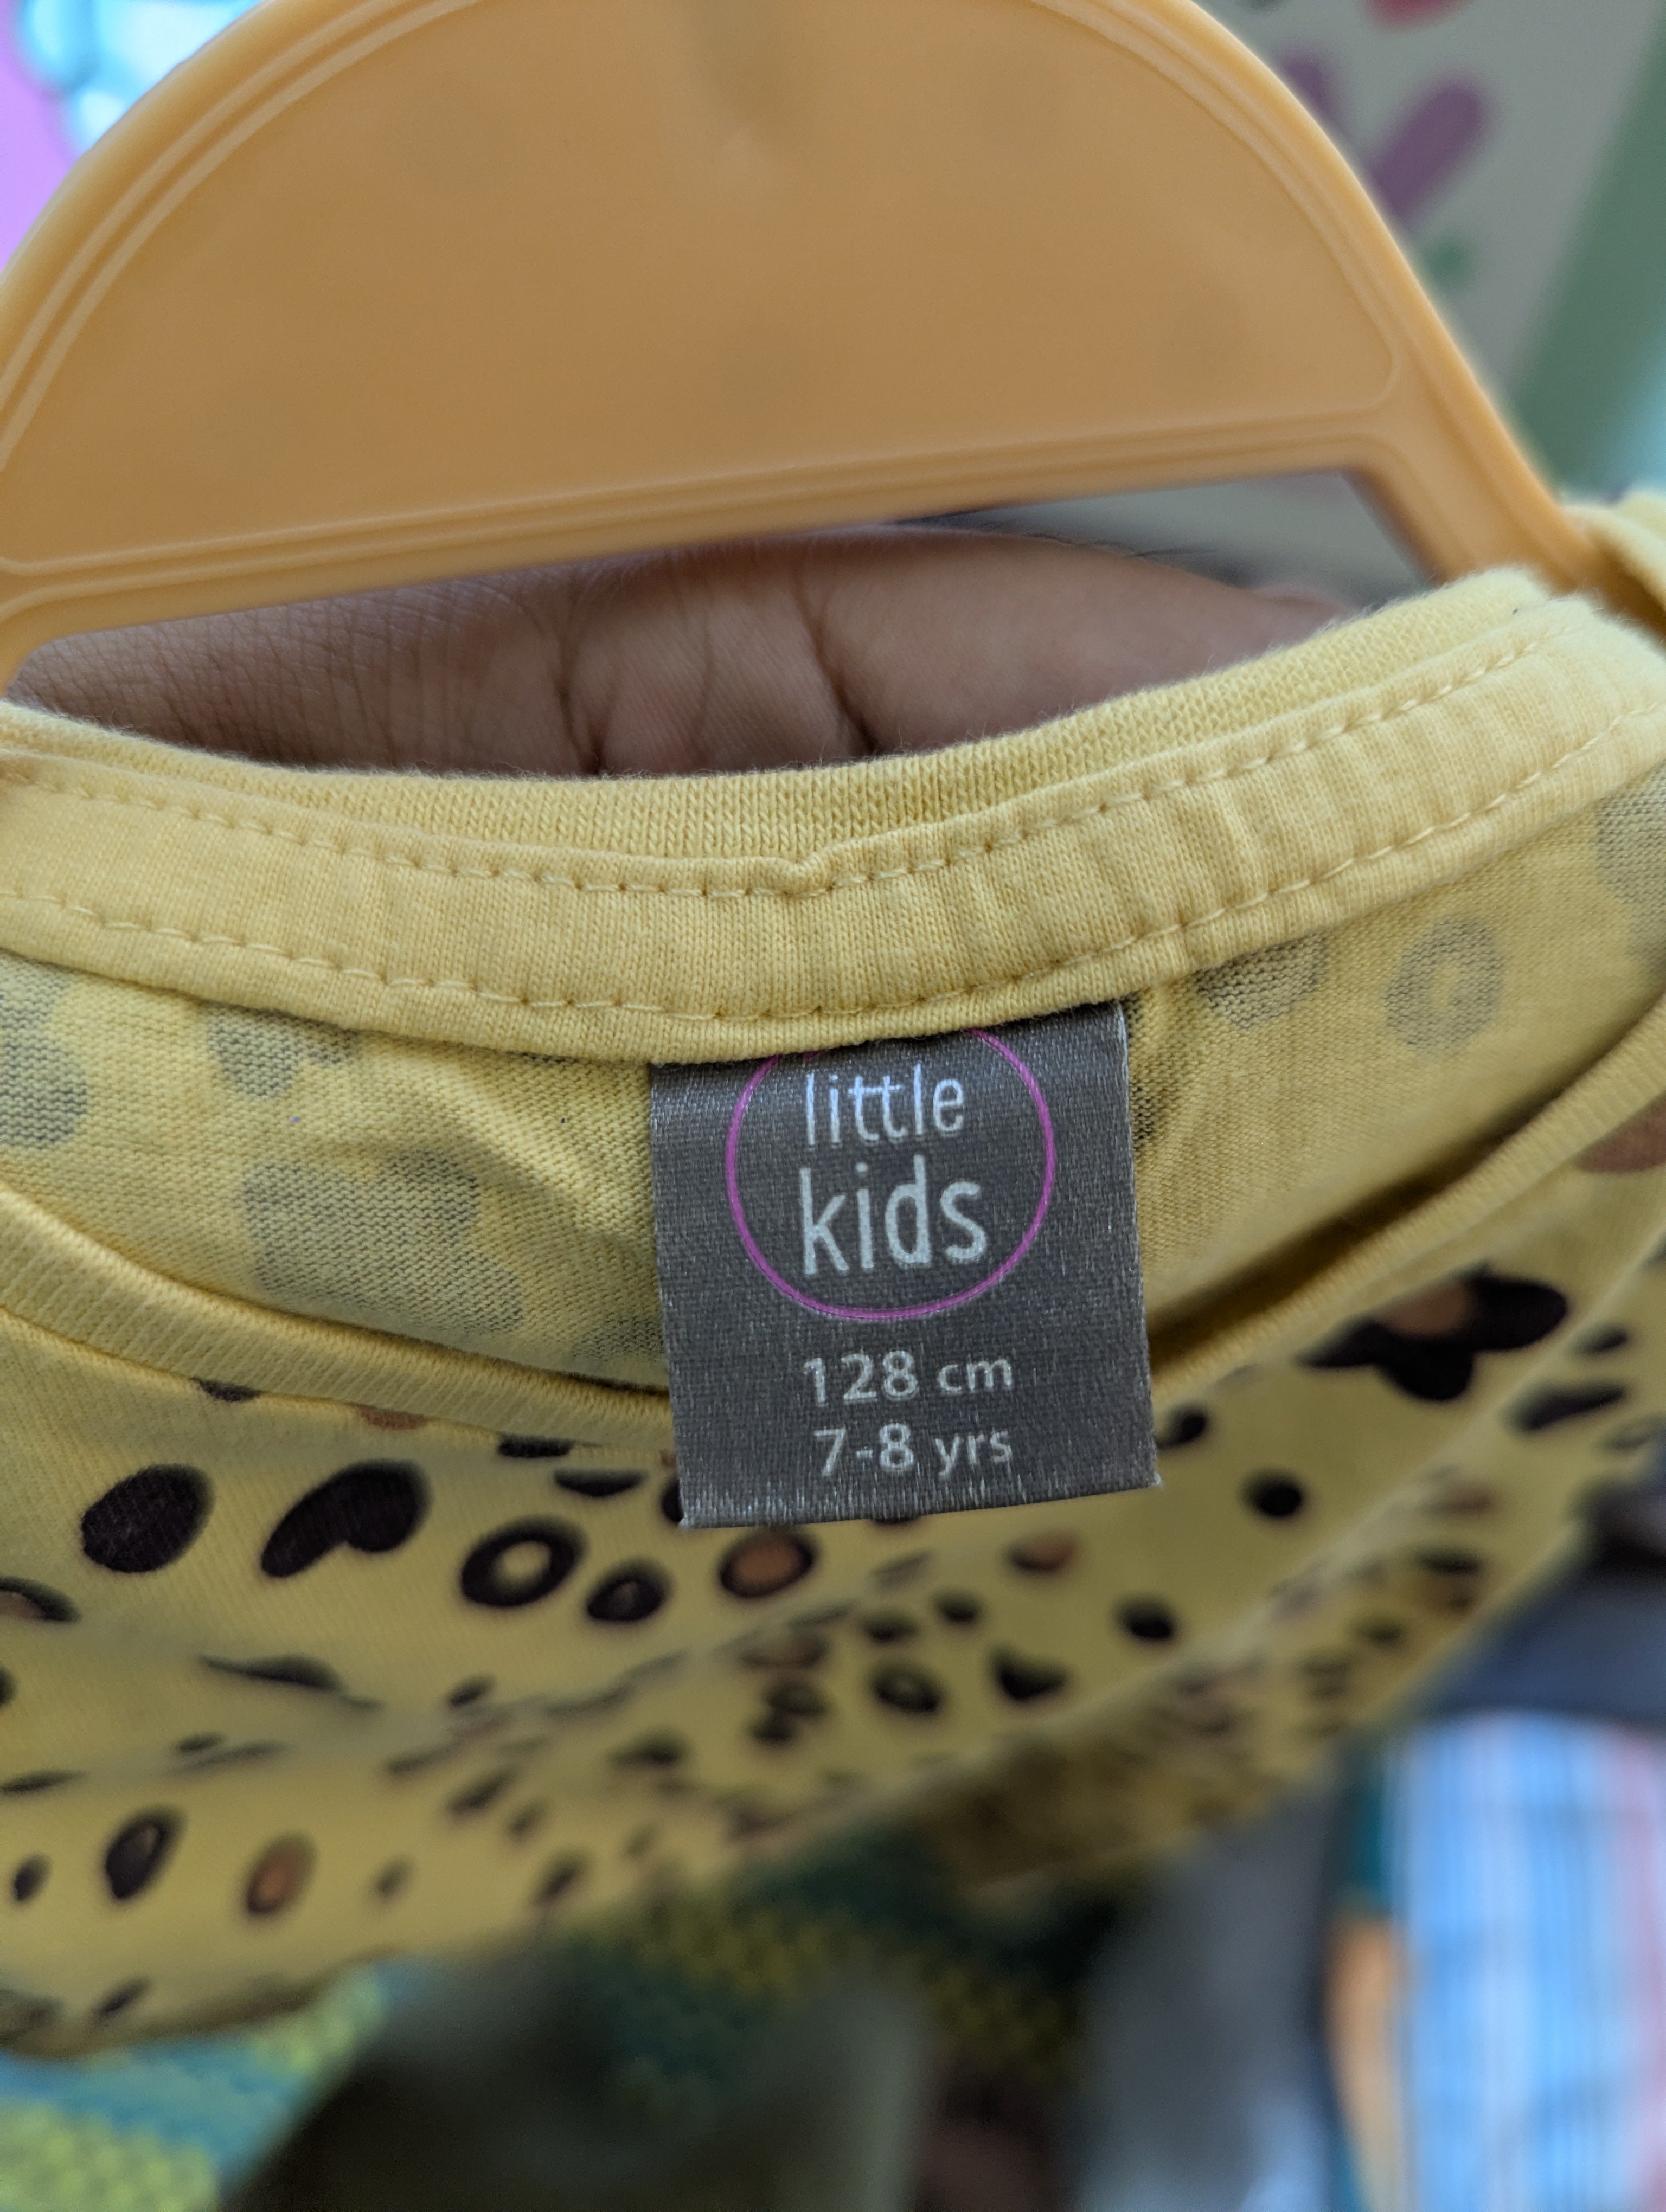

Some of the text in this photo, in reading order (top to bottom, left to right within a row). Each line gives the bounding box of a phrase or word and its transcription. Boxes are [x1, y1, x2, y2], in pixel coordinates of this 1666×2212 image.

[805, 1063, 965, 1147] little
[799, 1154, 988, 1275] kids
[803, 1349, 1013, 1407] 128 cm
[813, 1422, 1013, 1478] 7-8 yrs
